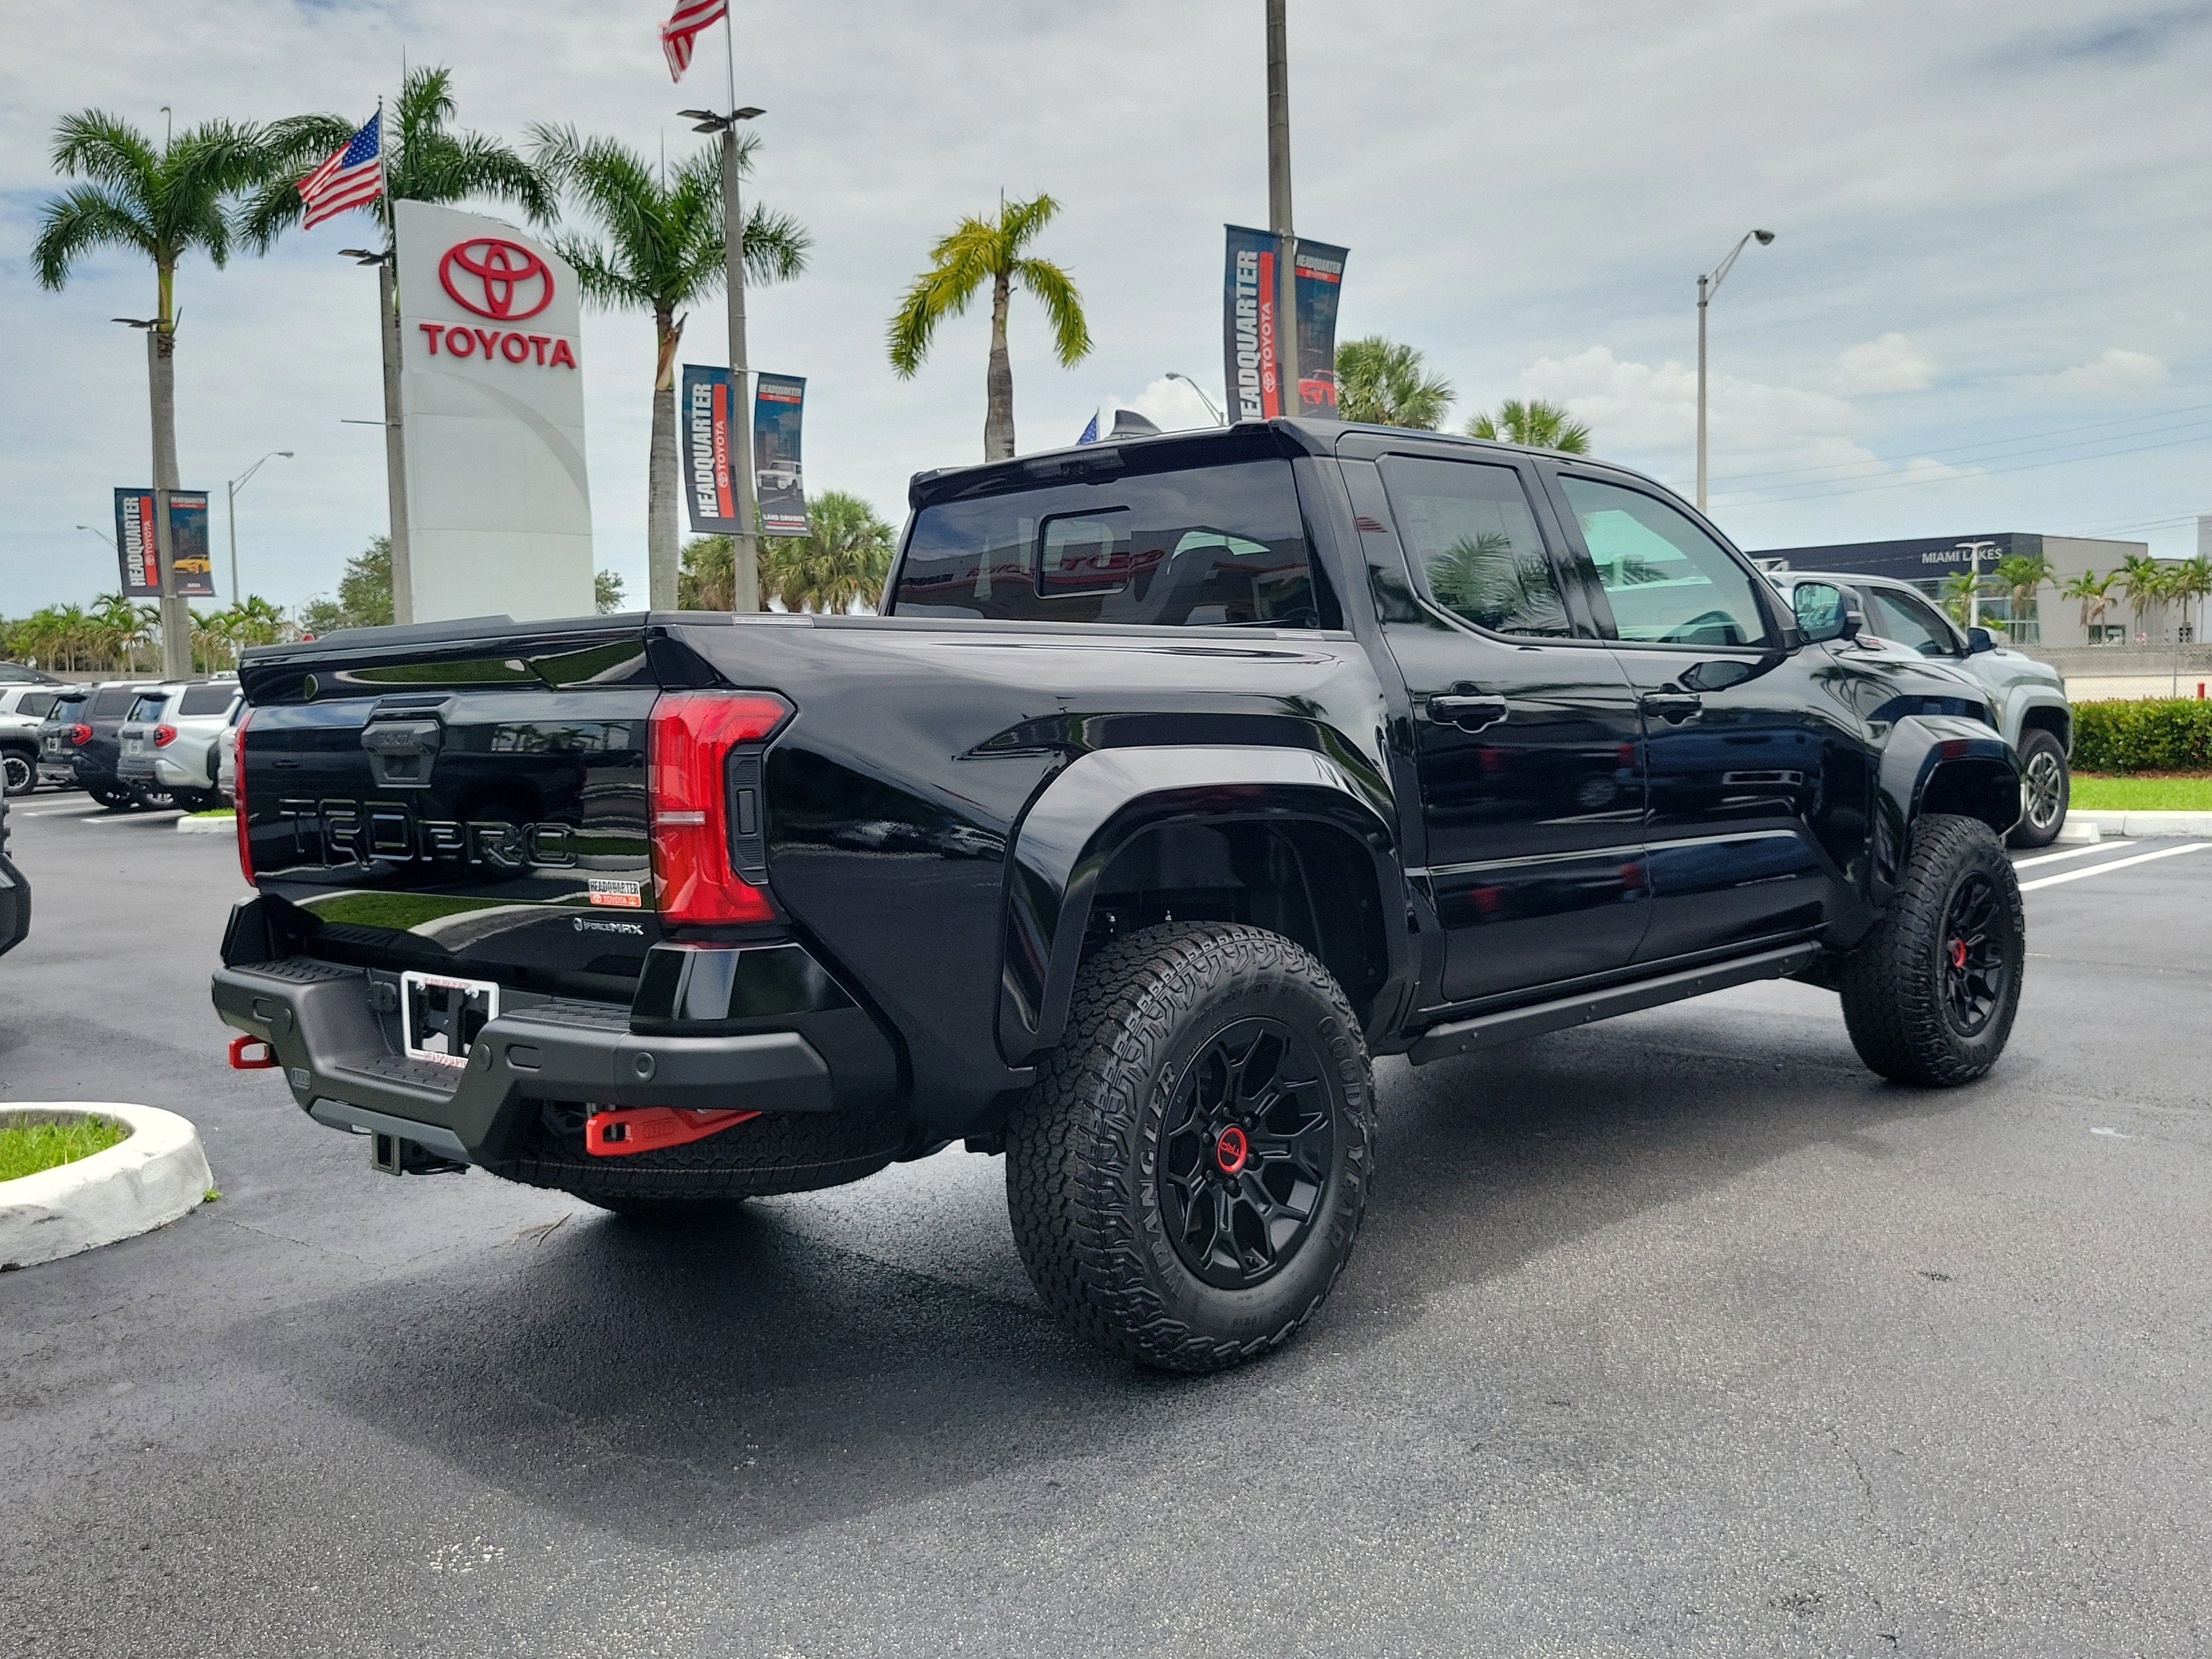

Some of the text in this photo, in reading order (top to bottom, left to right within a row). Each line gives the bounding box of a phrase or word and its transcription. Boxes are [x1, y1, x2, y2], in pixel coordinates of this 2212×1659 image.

[419, 324, 577, 369] TOYOTA
[1262, 303, 1273, 370] TOYOTA
[692, 383, 720, 518] HEADQUARTER
[715, 421, 726, 471] TOYOTA
[124, 496, 146, 586] HEADQUARTER
[143, 521, 153, 555] TOYOTA
[1922, 550, 1960, 564] MIAMI
[279, 798, 577, 871] TRD PRO
[590, 881, 639, 894] HEADQUARTER
[604, 895, 628, 904] TOYOTA
